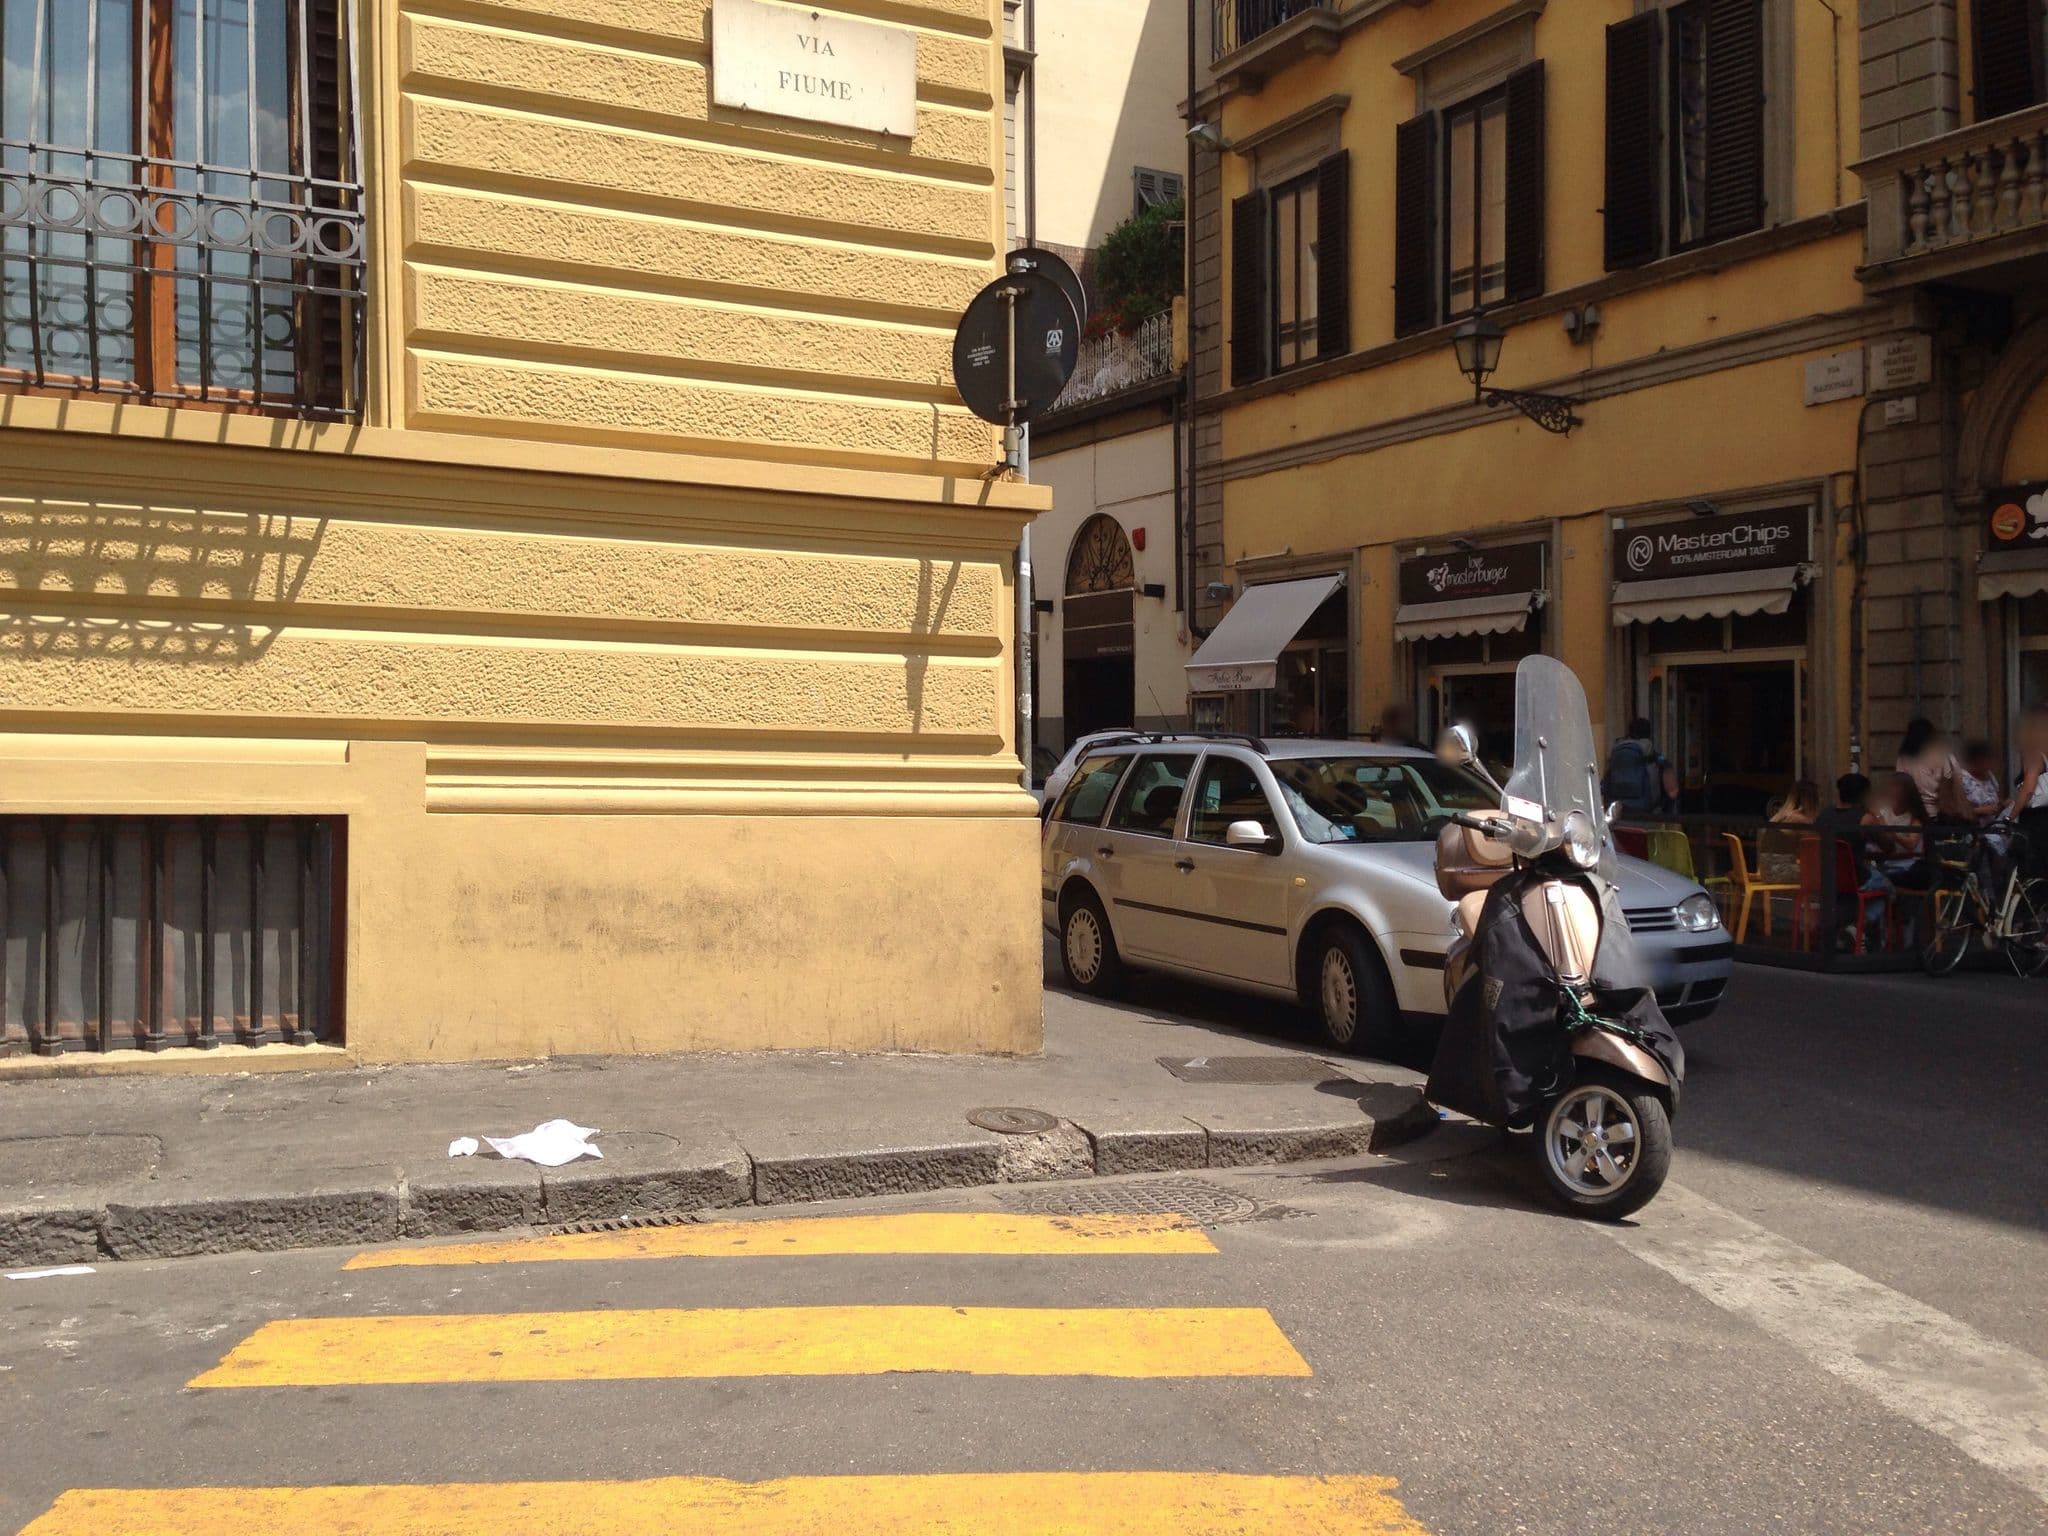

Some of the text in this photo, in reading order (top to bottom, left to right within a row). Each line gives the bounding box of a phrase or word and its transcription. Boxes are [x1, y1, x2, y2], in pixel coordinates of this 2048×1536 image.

[797, 34, 835, 56] VIA
[778, 70, 852, 101] FIUME
[1658, 523, 1790, 552] MasterChips
[1694, 550, 1746, 563] AMSTERDAM
[1749, 545, 1776, 556] TASTE
